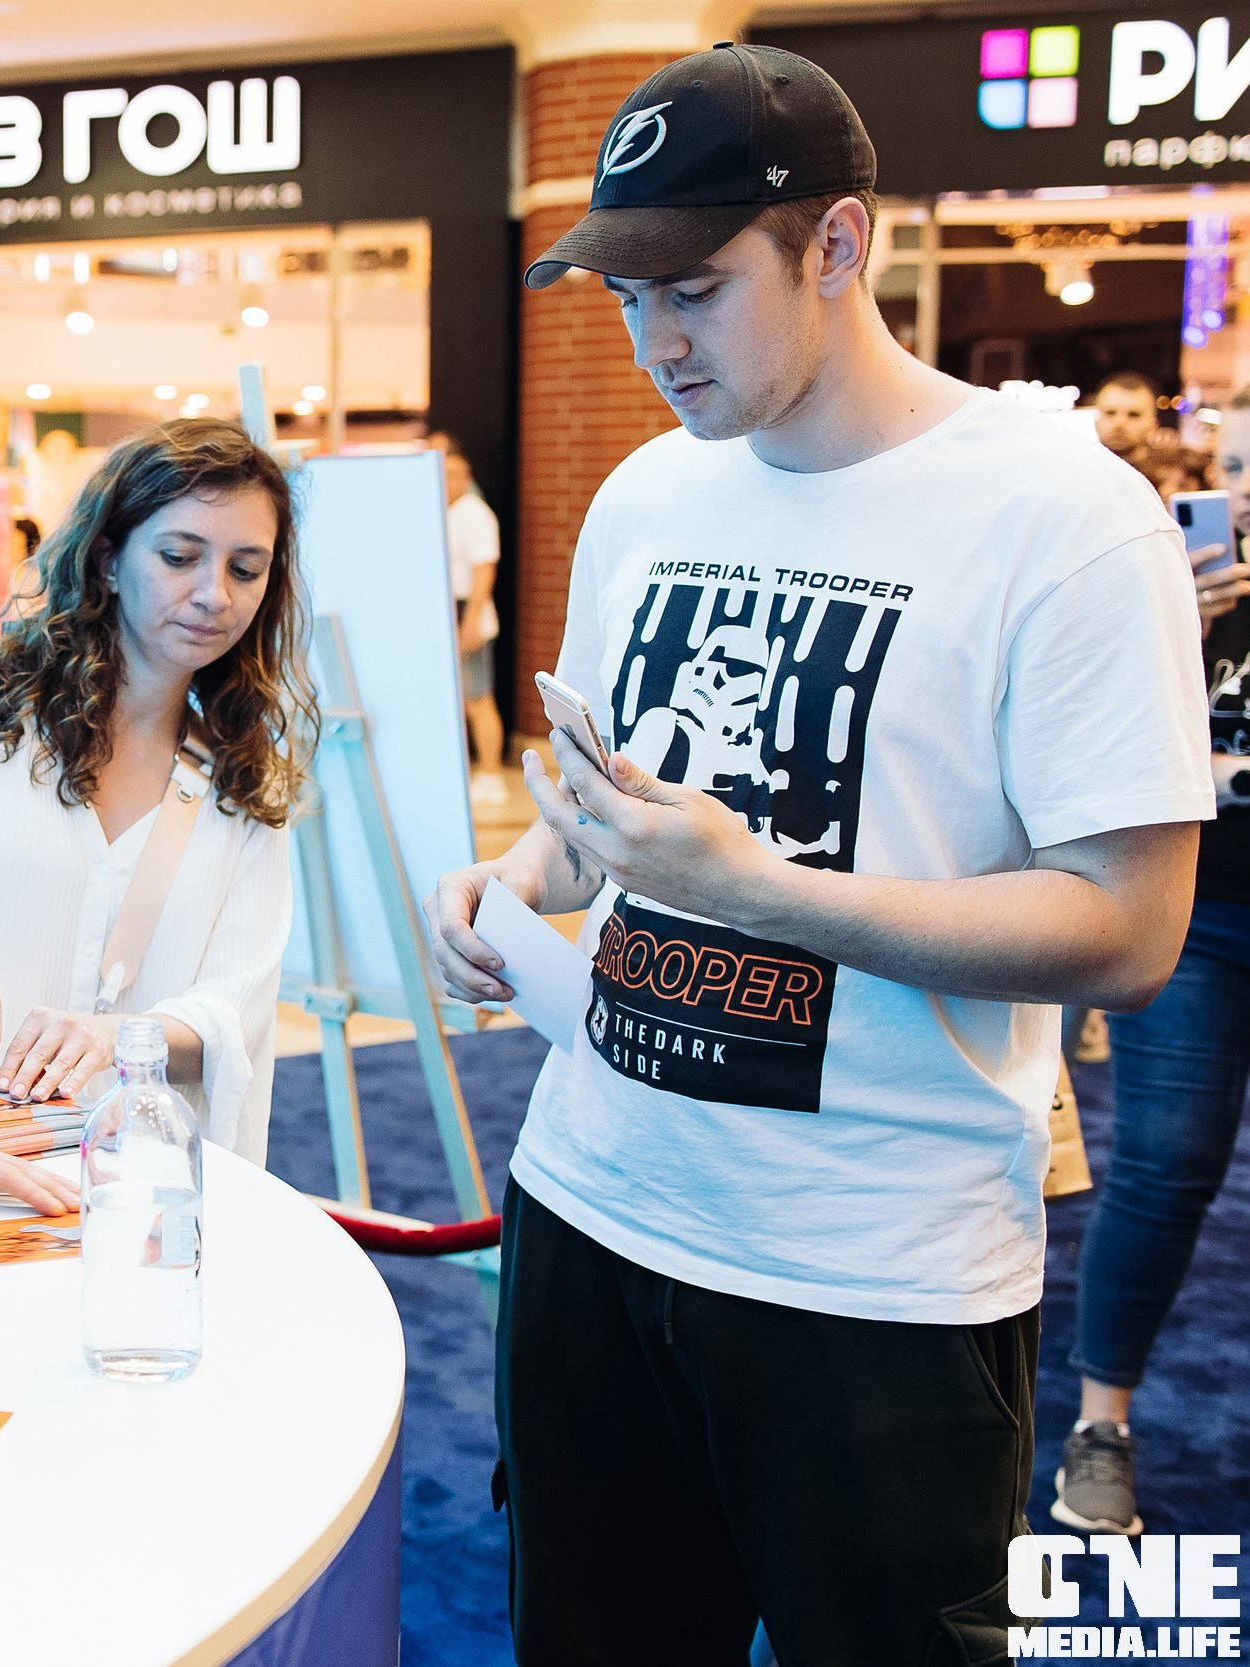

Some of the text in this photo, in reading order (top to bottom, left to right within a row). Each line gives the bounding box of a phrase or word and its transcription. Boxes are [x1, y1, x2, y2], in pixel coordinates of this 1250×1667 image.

[63, 75, 301, 184] ГОШ
[649, 561, 914, 602] IMPERIAL TROOPER
[595, 912, 823, 1026] TROOPER
[613, 1044, 662, 1081] SIDE
